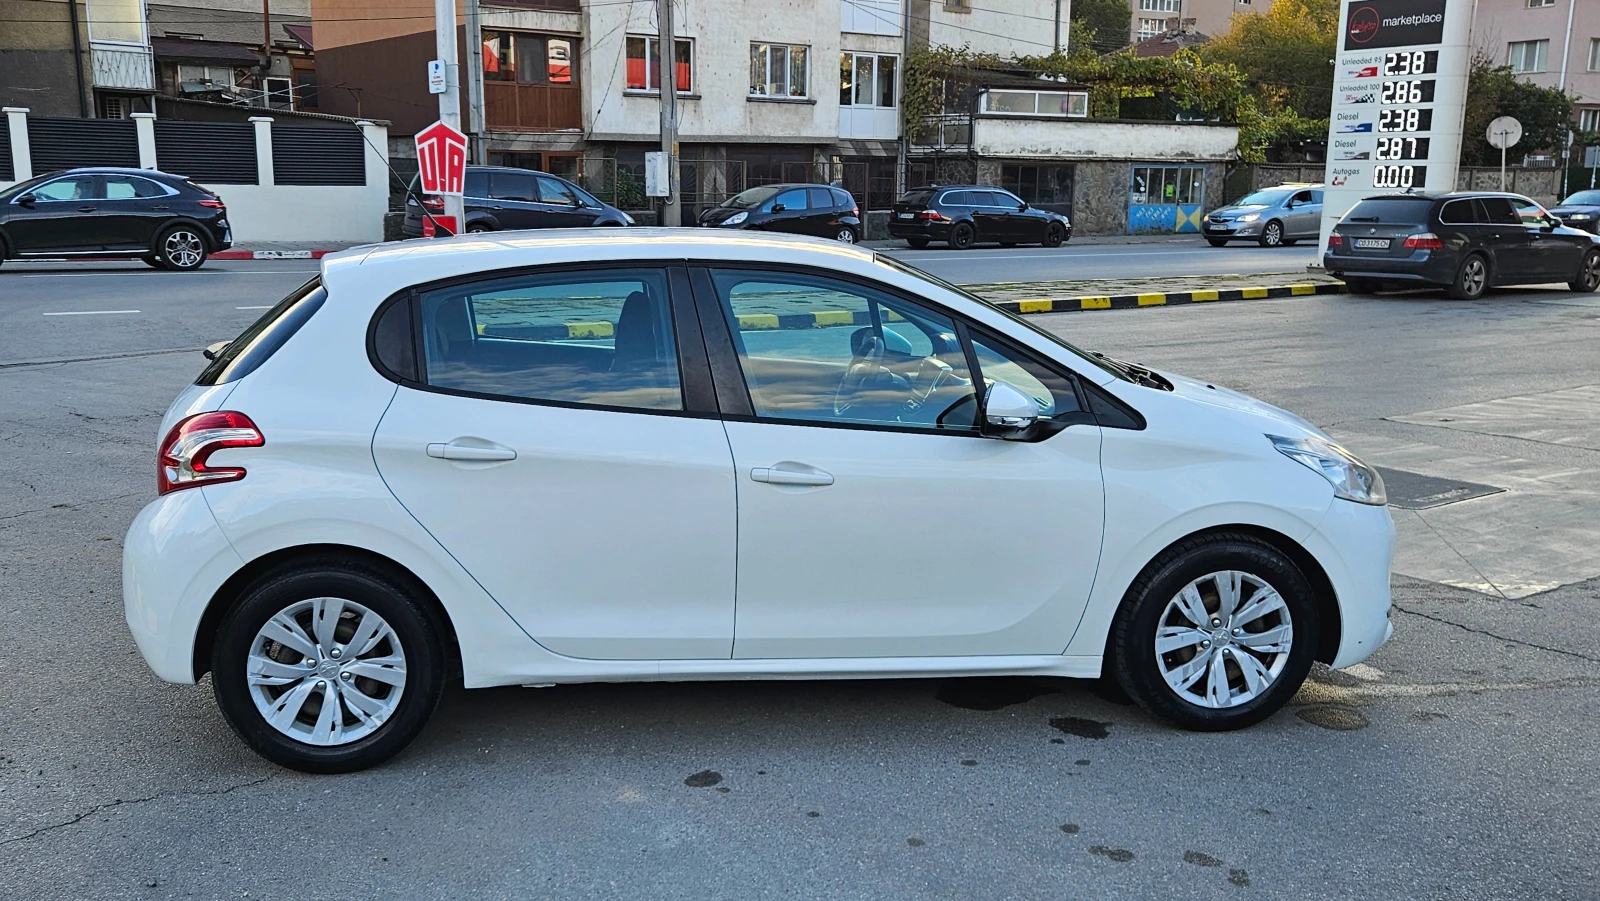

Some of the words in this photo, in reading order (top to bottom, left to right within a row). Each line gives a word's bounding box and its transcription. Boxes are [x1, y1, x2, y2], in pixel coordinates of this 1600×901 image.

[1382, 13, 1442, 27] marketplace
[1342, 57, 1372, 65] Unleaded
[1374, 56, 1382, 64] 95
[1384, 51, 1426, 76] 2.38
[1339, 84, 1368, 92] Unleaded
[1369, 83, 1380, 91] 100
[1381, 80, 1422, 104] 2.86
[1337, 112, 1359, 120] Diesel
[1378, 108, 1420, 132] 2.38
[1334, 140, 1357, 148] Diesel
[1376, 137, 1417, 160] 2.87
[1332, 168, 1360, 176] Autogas
[1373, 165, 1414, 188] 0.00
